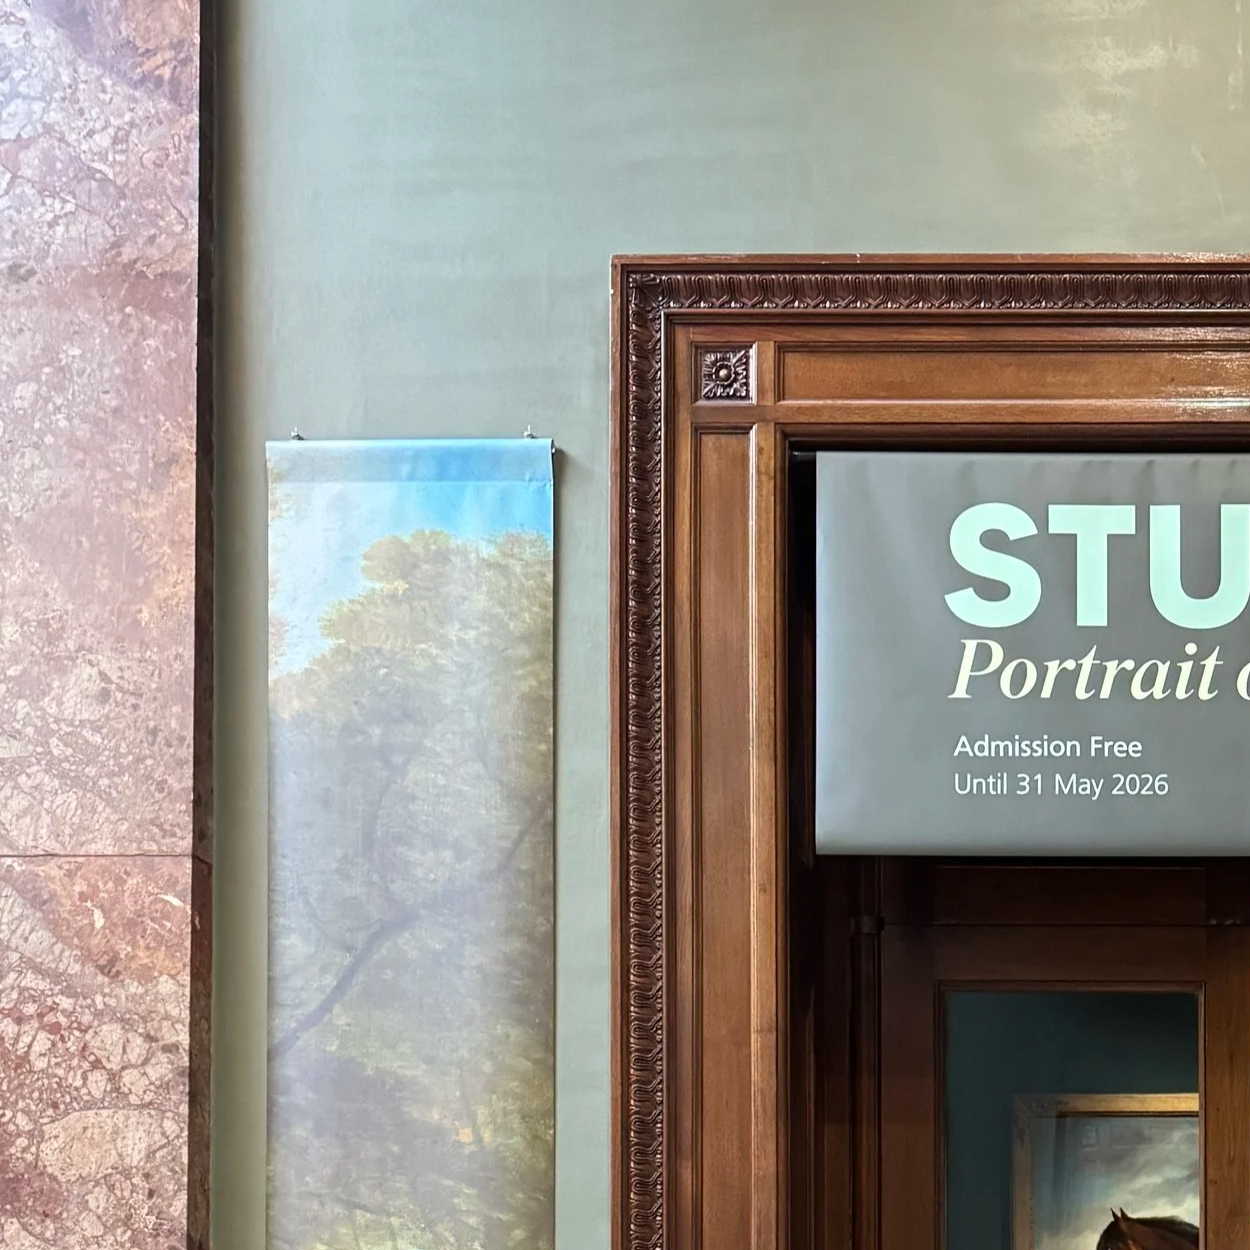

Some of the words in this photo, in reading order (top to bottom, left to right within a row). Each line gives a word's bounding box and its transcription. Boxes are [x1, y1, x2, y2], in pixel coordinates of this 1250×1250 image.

[947, 639, 1224, 701] Portrait
[953, 734, 1081, 757] Admission
[1090, 735, 1143, 758] Free
[954, 772, 1008, 795] Until
[1016, 773, 1043, 795] 31
[1055, 773, 1105, 801] May
[1111, 773, 1169, 795] 2026
